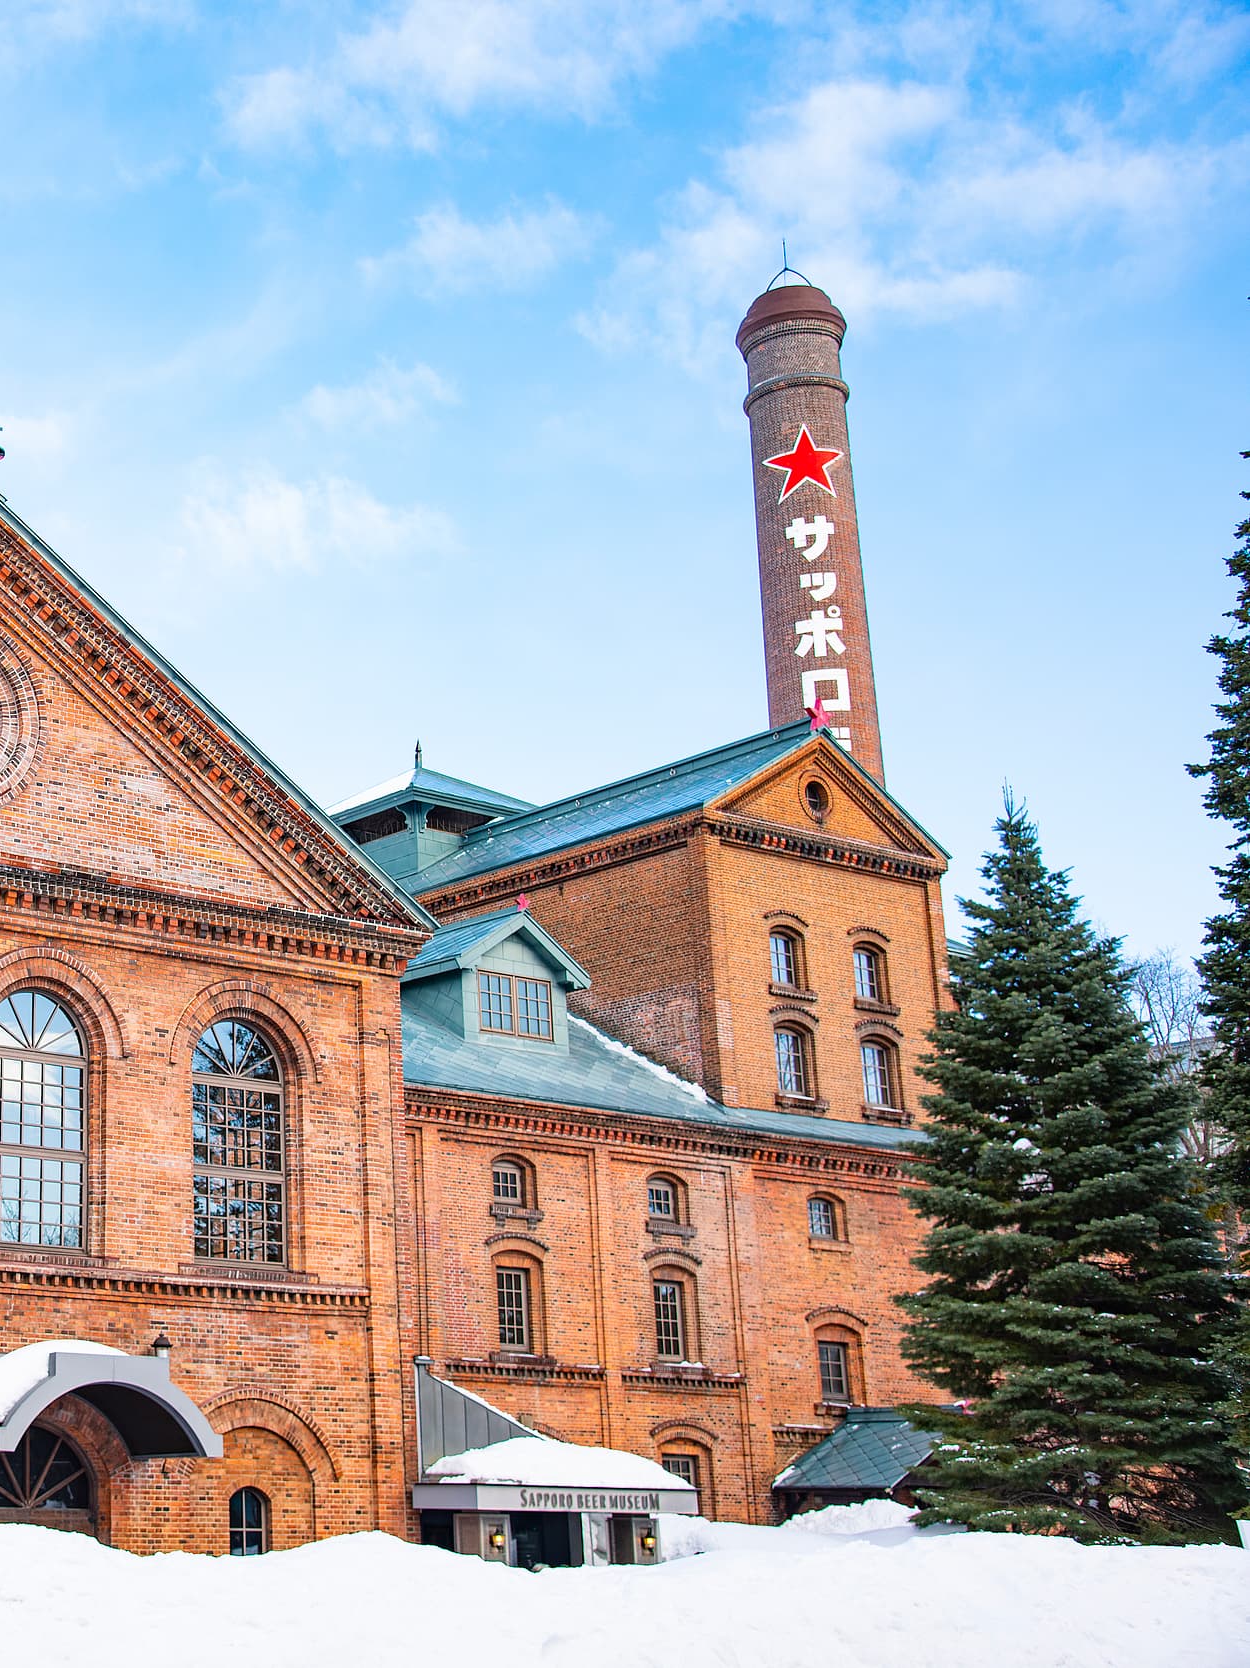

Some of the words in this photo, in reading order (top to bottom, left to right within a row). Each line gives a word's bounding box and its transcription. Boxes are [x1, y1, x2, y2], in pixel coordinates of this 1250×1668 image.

[520, 1488, 573, 1508] SAPPORO
[576, 1494, 607, 1509] BEER
[609, 1493, 660, 1511] MUSEUM
